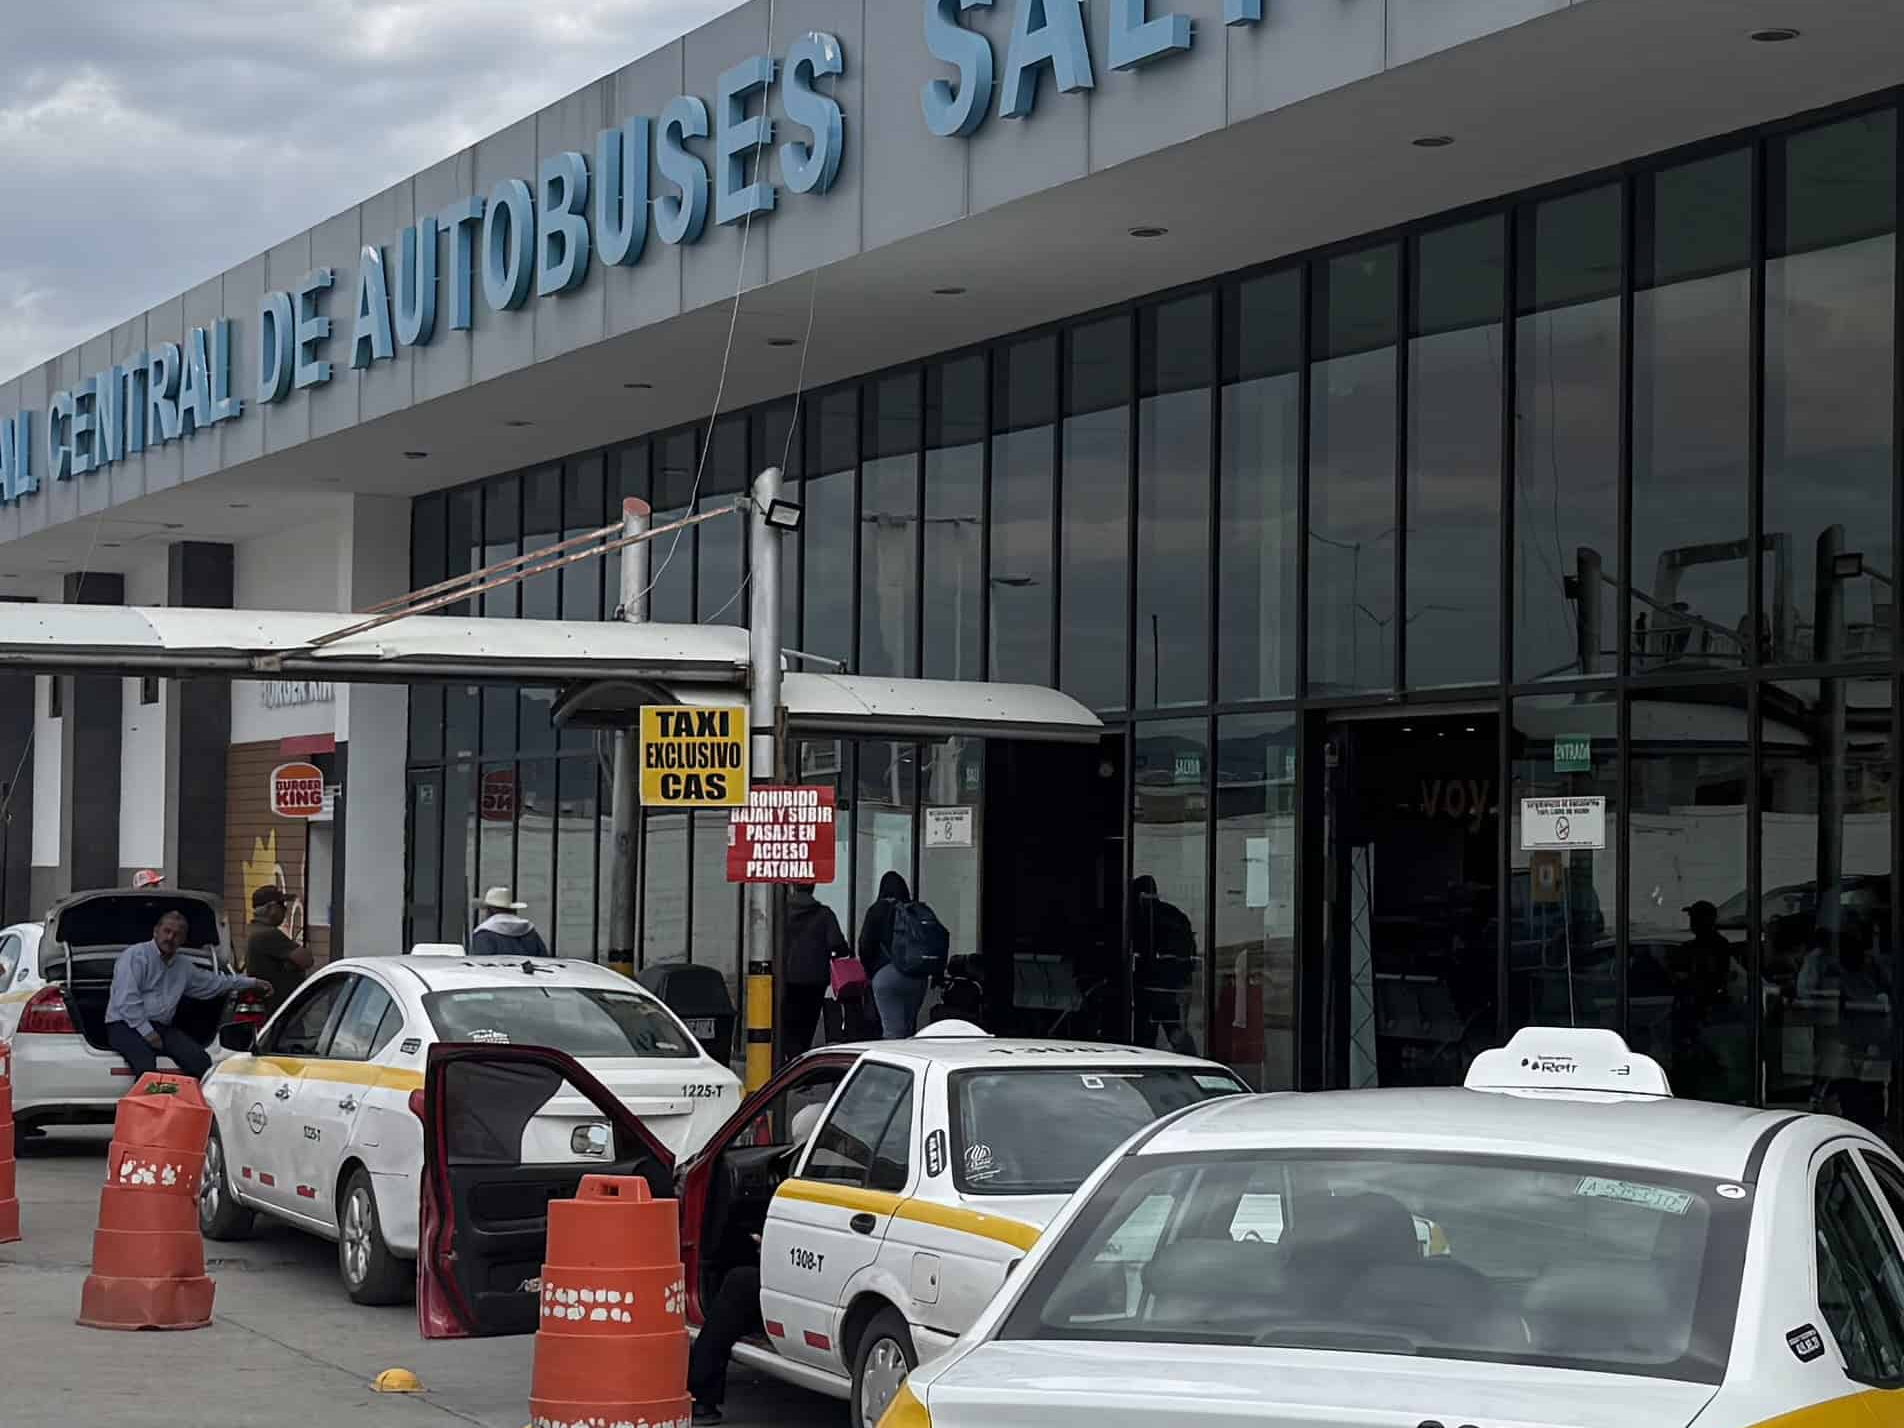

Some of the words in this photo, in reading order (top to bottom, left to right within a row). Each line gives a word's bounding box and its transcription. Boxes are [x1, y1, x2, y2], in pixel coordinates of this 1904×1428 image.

[48, 317, 243, 481] CENTRAL
[256, 267, 334, 403] DE
[349, 30, 844, 369] AUTOBUSES
[656, 711, 729, 737] TAXI
[647, 742, 740, 769] EXCLUSIVO
[276, 780, 321, 791] BURGER
[661, 773, 727, 801] CAS
[276, 790, 322, 806] KING
[750, 790, 818, 807] ROHIBIDO
[731, 808, 774, 823] BAJAR
[777, 808, 786, 823] Y
[789, 807, 832, 823] SUBIR
[746, 825, 795, 841] PASAJE
[799, 824, 816, 841] EN
[752, 843, 809, 860] ACCESO
[746, 861, 815, 878] PEATONAL
[681, 1084, 724, 1098] 1225-T
[790, 1247, 825, 1273] 1308-T
